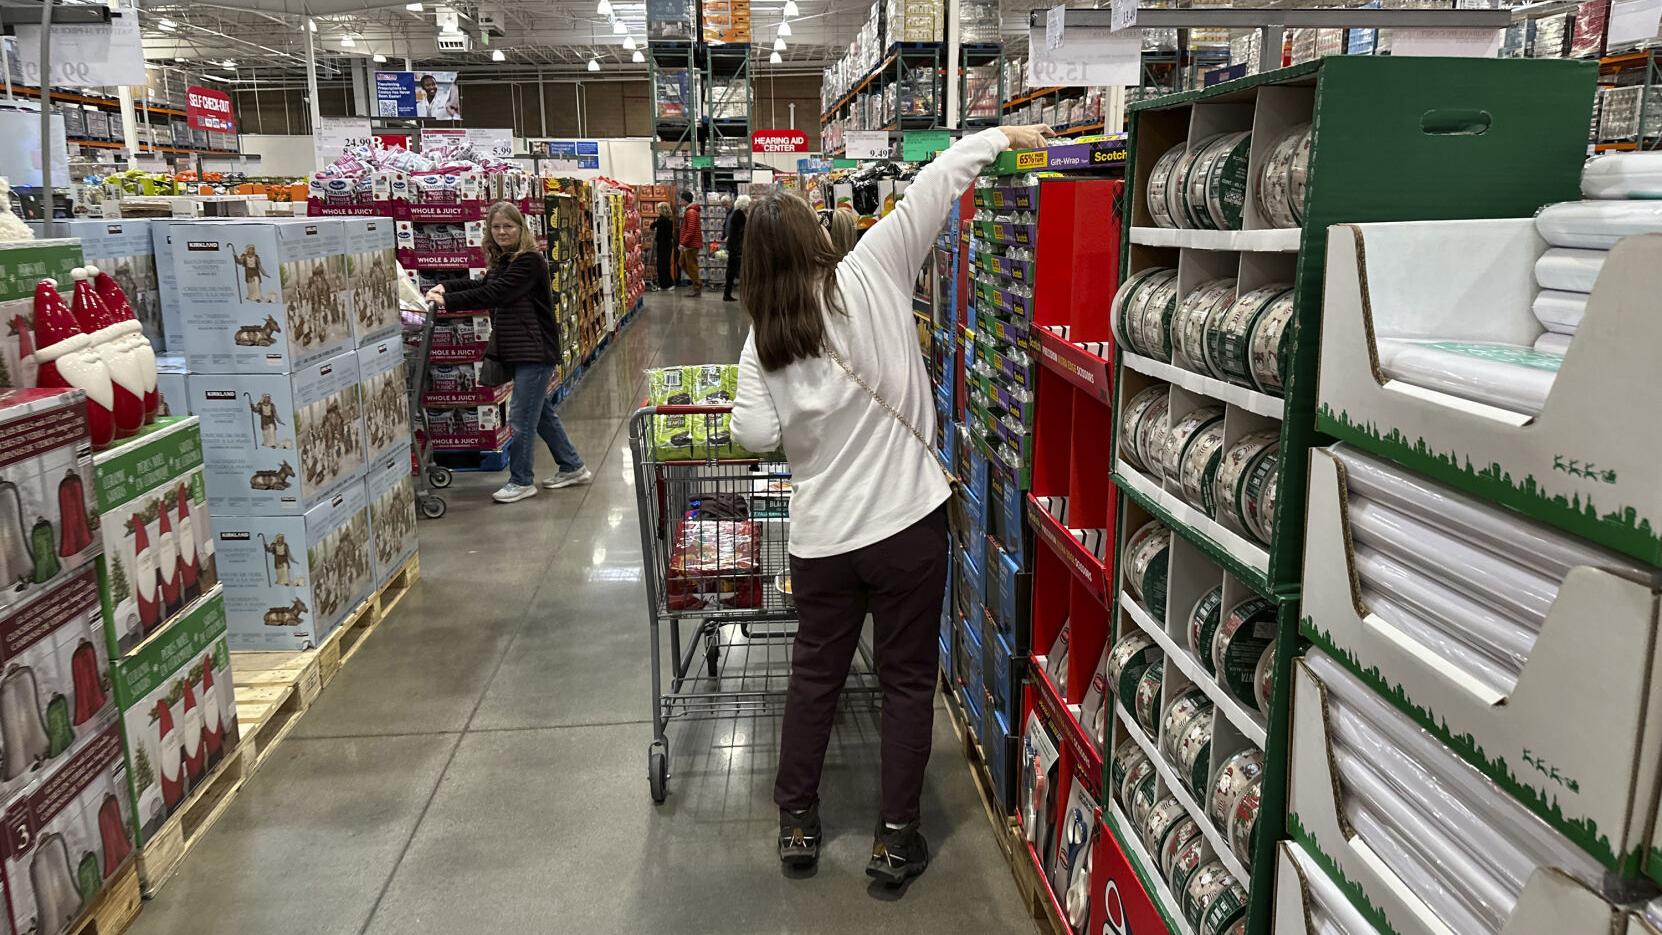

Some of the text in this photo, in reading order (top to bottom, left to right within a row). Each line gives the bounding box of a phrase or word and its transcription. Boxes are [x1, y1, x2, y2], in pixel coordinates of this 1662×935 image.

[189, 93, 230, 113] SELF CHECK-OUT
[344, 137, 372, 148] 24.99
[754, 136, 804, 145] HEARING AID
[492, 147, 512, 156] 5.99
[764, 144, 795, 152] CENTER
[870, 149, 888, 158] 9.49
[1094, 150, 1127, 162] Scotch
[1019, 154, 1035, 164] 65%
[1050, 156, 1080, 166] Gift-Wrap
[16, 824, 30, 850] 3
